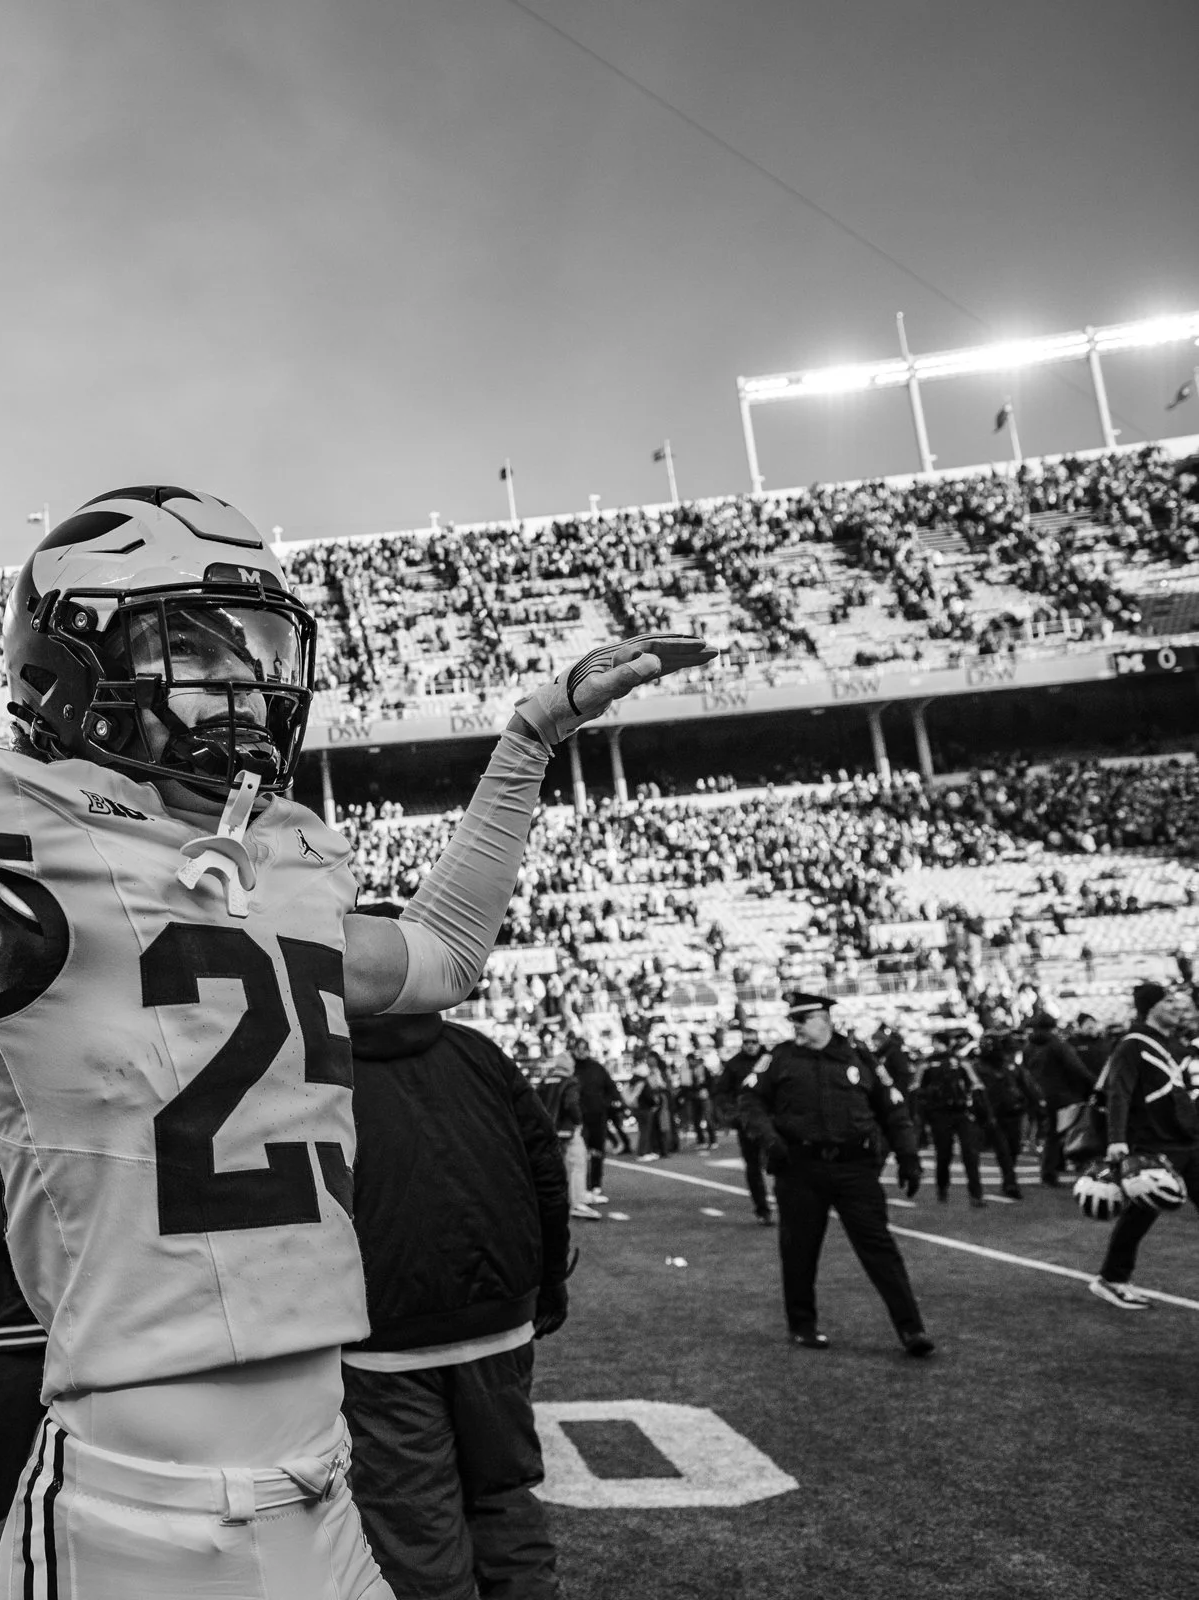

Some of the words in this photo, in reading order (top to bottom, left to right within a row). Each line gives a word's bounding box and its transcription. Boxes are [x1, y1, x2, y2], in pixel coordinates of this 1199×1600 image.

[237, 567, 261, 584] M
[831, 678, 882, 699] DSW
[704, 690, 750, 712] DSW
[452, 714, 496, 733] DSW
[327, 724, 375, 744] DSW
[139, 921, 356, 1236] 25
